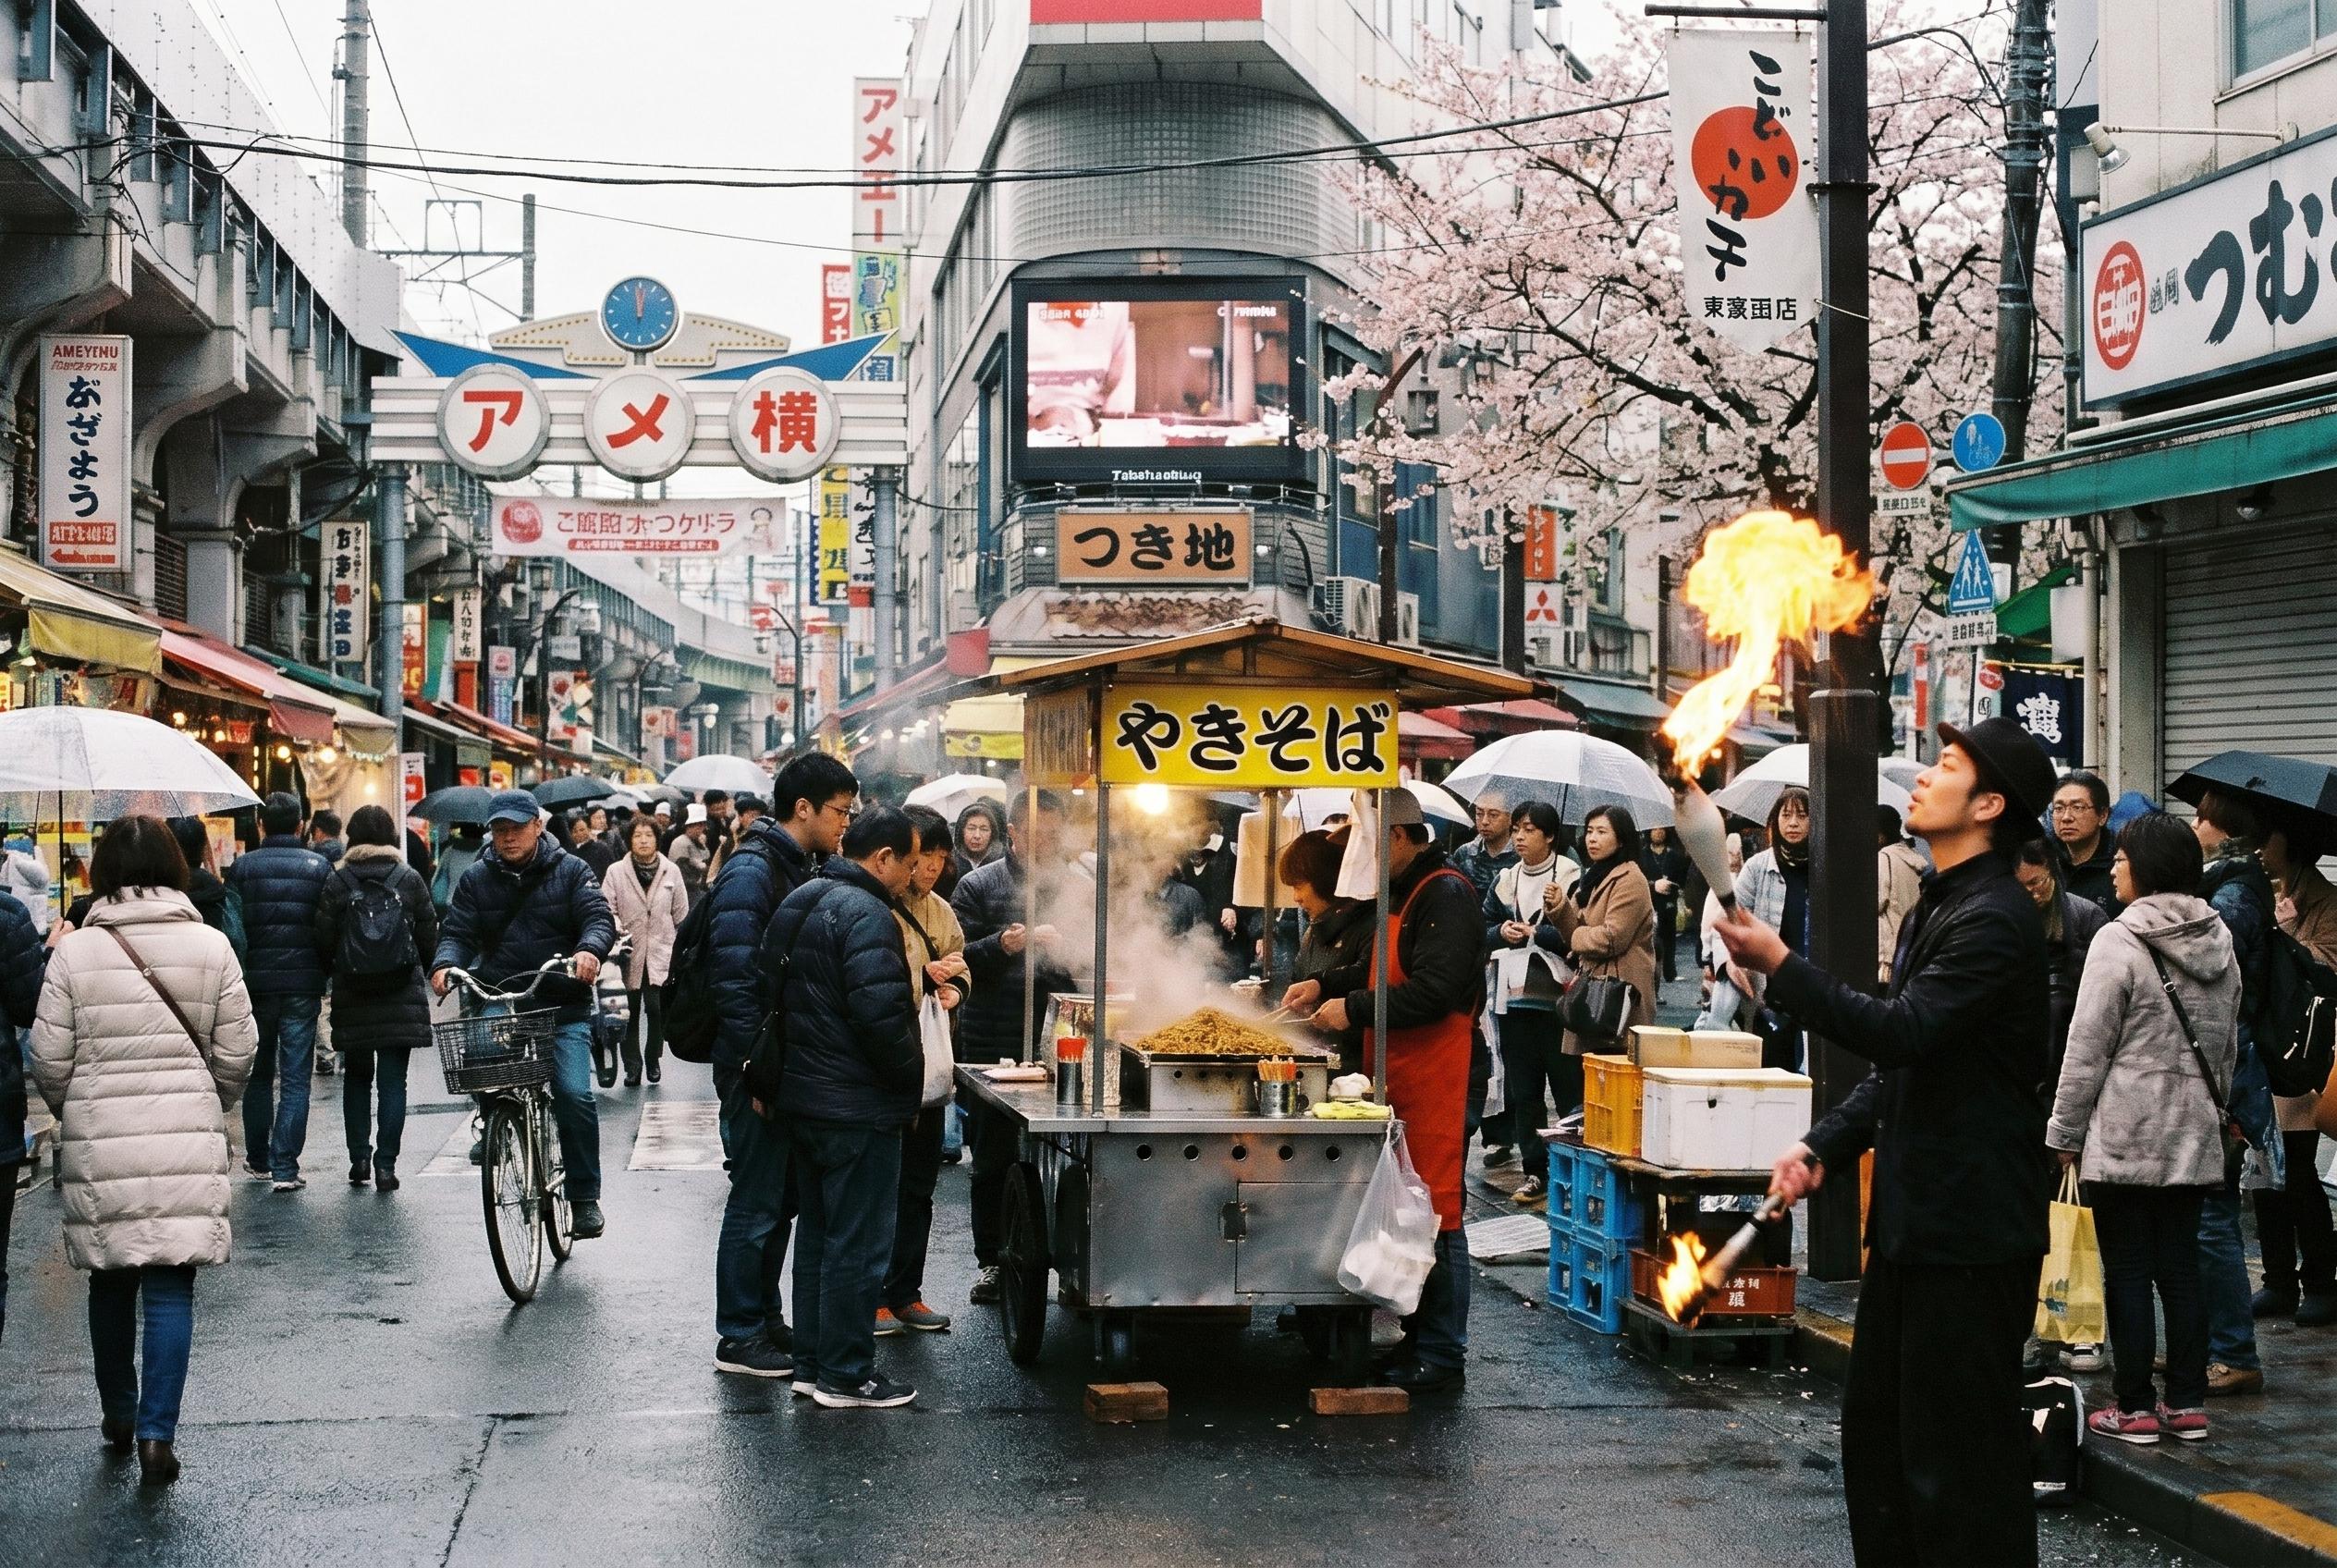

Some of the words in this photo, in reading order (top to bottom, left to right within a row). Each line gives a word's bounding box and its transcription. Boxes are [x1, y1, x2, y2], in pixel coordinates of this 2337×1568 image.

[2184, 176, 2337, 346] つむ
[463, 390, 817, 455] アメ横
[1073, 521, 1236, 571] つき地
[1116, 701, 1390, 773] やきそば
